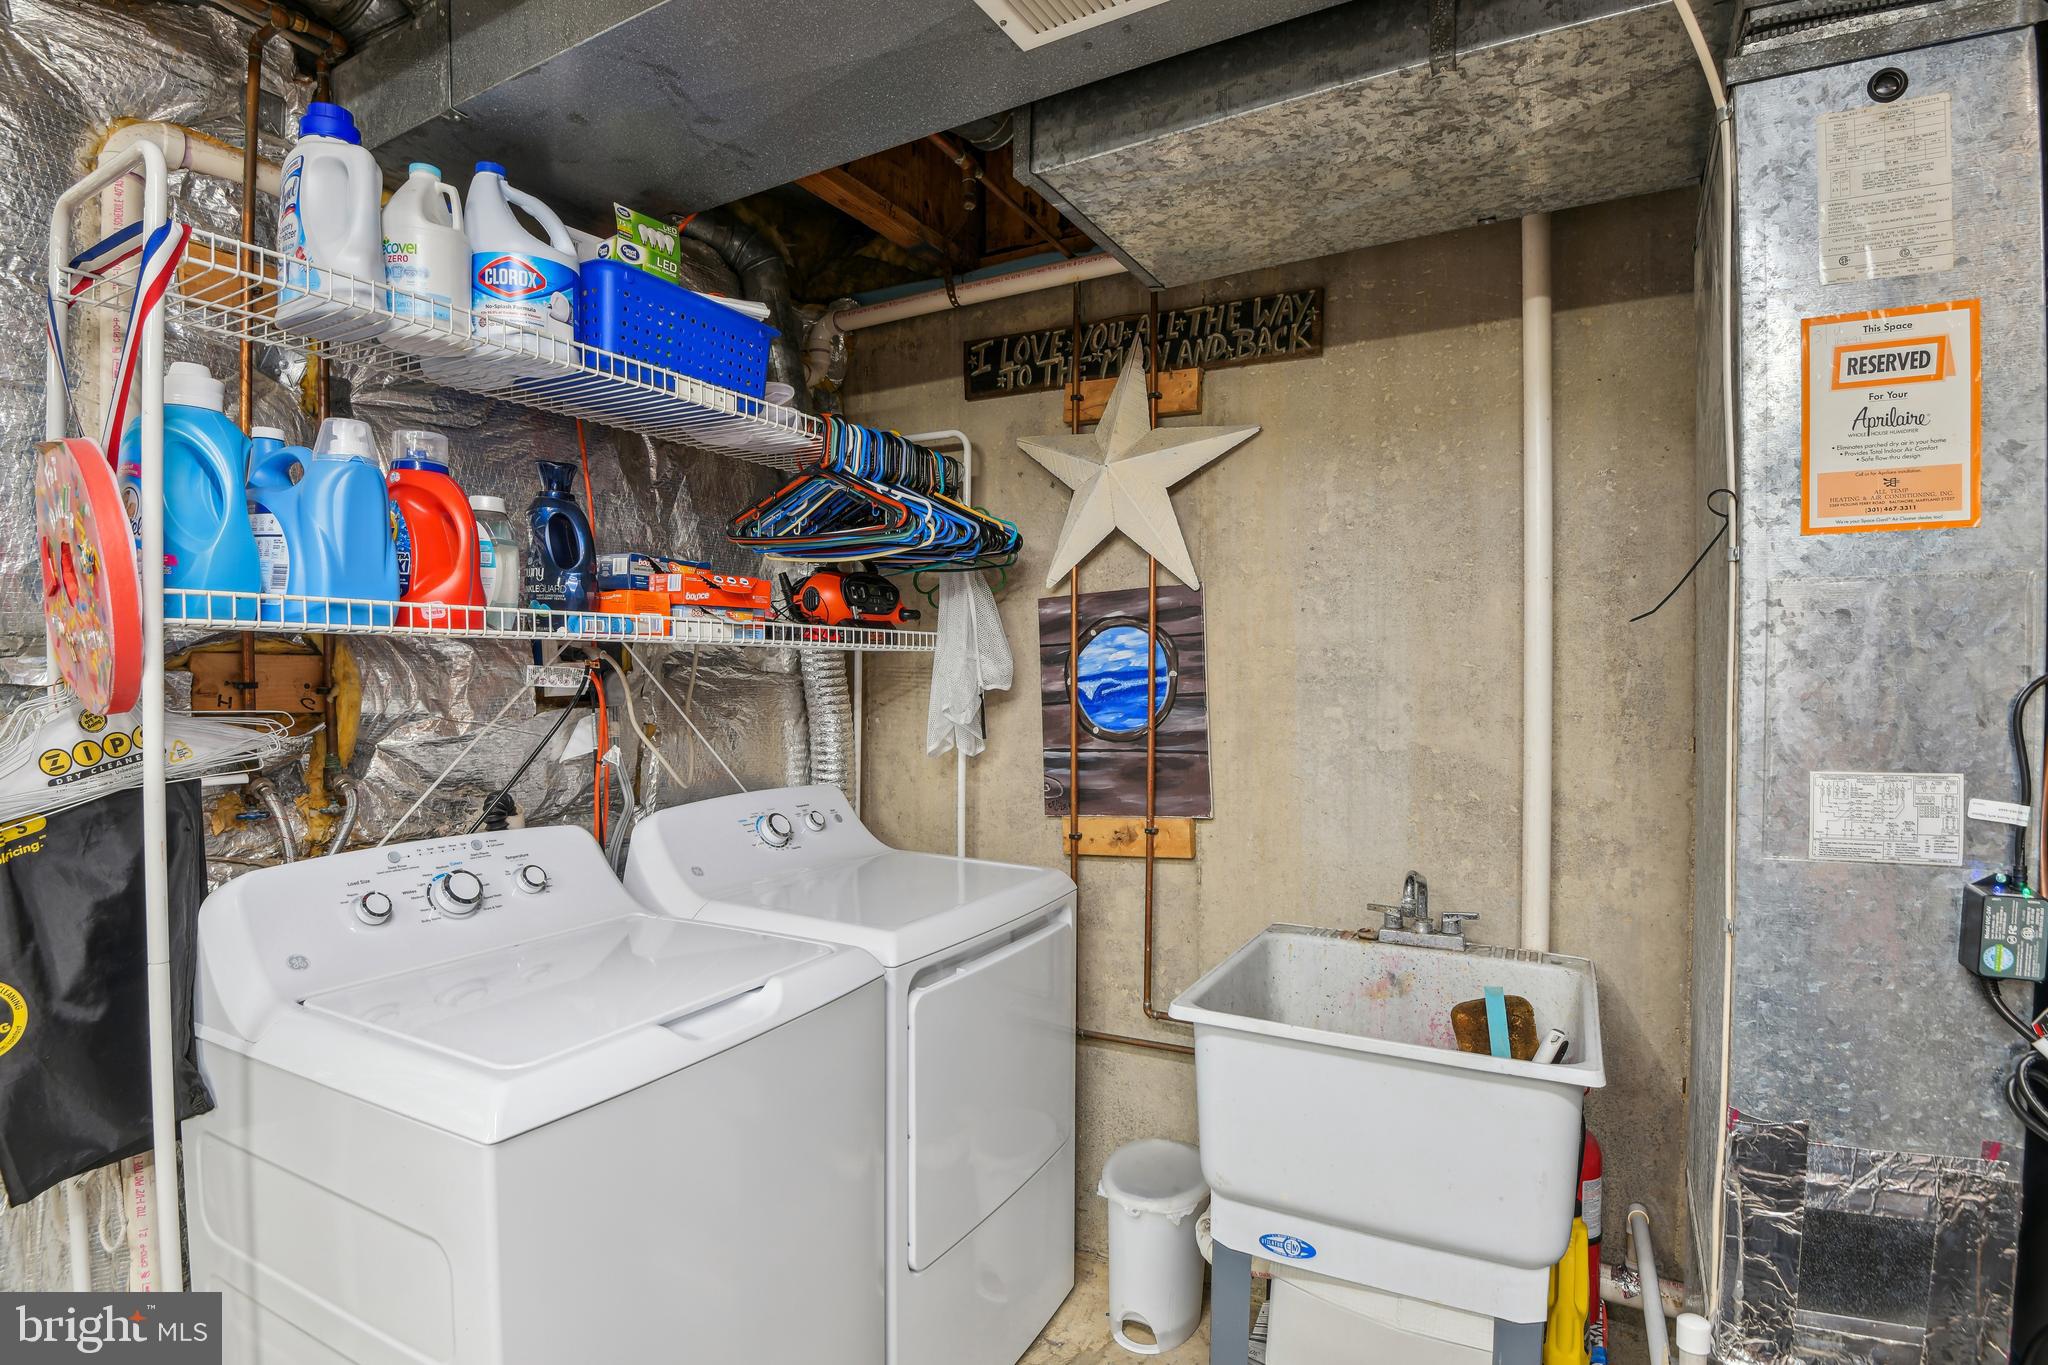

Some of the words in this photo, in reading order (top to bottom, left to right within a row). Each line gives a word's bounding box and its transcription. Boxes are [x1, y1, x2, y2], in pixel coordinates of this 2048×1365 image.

[387, 255, 409, 263] ZERO
[656, 256, 678, 273] LED
[484, 268, 538, 289] CLOROX
[1000, 329, 1066, 370] LOVE
[1136, 311, 1179, 341] AL
[1184, 300, 1243, 337] THE
[1254, 289, 1316, 329] WAY
[1862, 323, 1881, 334] This
[1883, 321, 1914, 332] Space
[1003, 365, 1033, 392] TO
[1101, 340, 1169, 379] MON
[1178, 334, 1227, 369] AND
[1233, 324, 1312, 358] BACK
[1846, 349, 1932, 377] RESERVED
[1868, 392, 1883, 401] For
[1886, 390, 1909, 400] Your
[1851, 406, 1930, 437] Aprilaire
[1836, 443, 1864, 451] Eliminates
[1865, 442, 1889, 451] parched
[1889, 440, 1900, 448] dry
[1915, 439, 1929, 447] your
[1844, 448, 1869, 457] Provides
[1884, 446, 1904, 454] Indoor
[1914, 444, 1939, 452] Comfort
[1901, 453, 1921, 461] design
[1829, 495, 1860, 503] HEATING
[638, 558, 651, 567] bou
[524, 567, 545, 582] wny
[526, 584, 567, 594] KLEGUARD
[685, 592, 710, 601] bounce
[56, 772, 82, 785] DRY
[91, 754, 142, 774] CLEANE
[115, 762, 144, 775] Unbeatabl
[6, 842, 44, 863] ricing.
